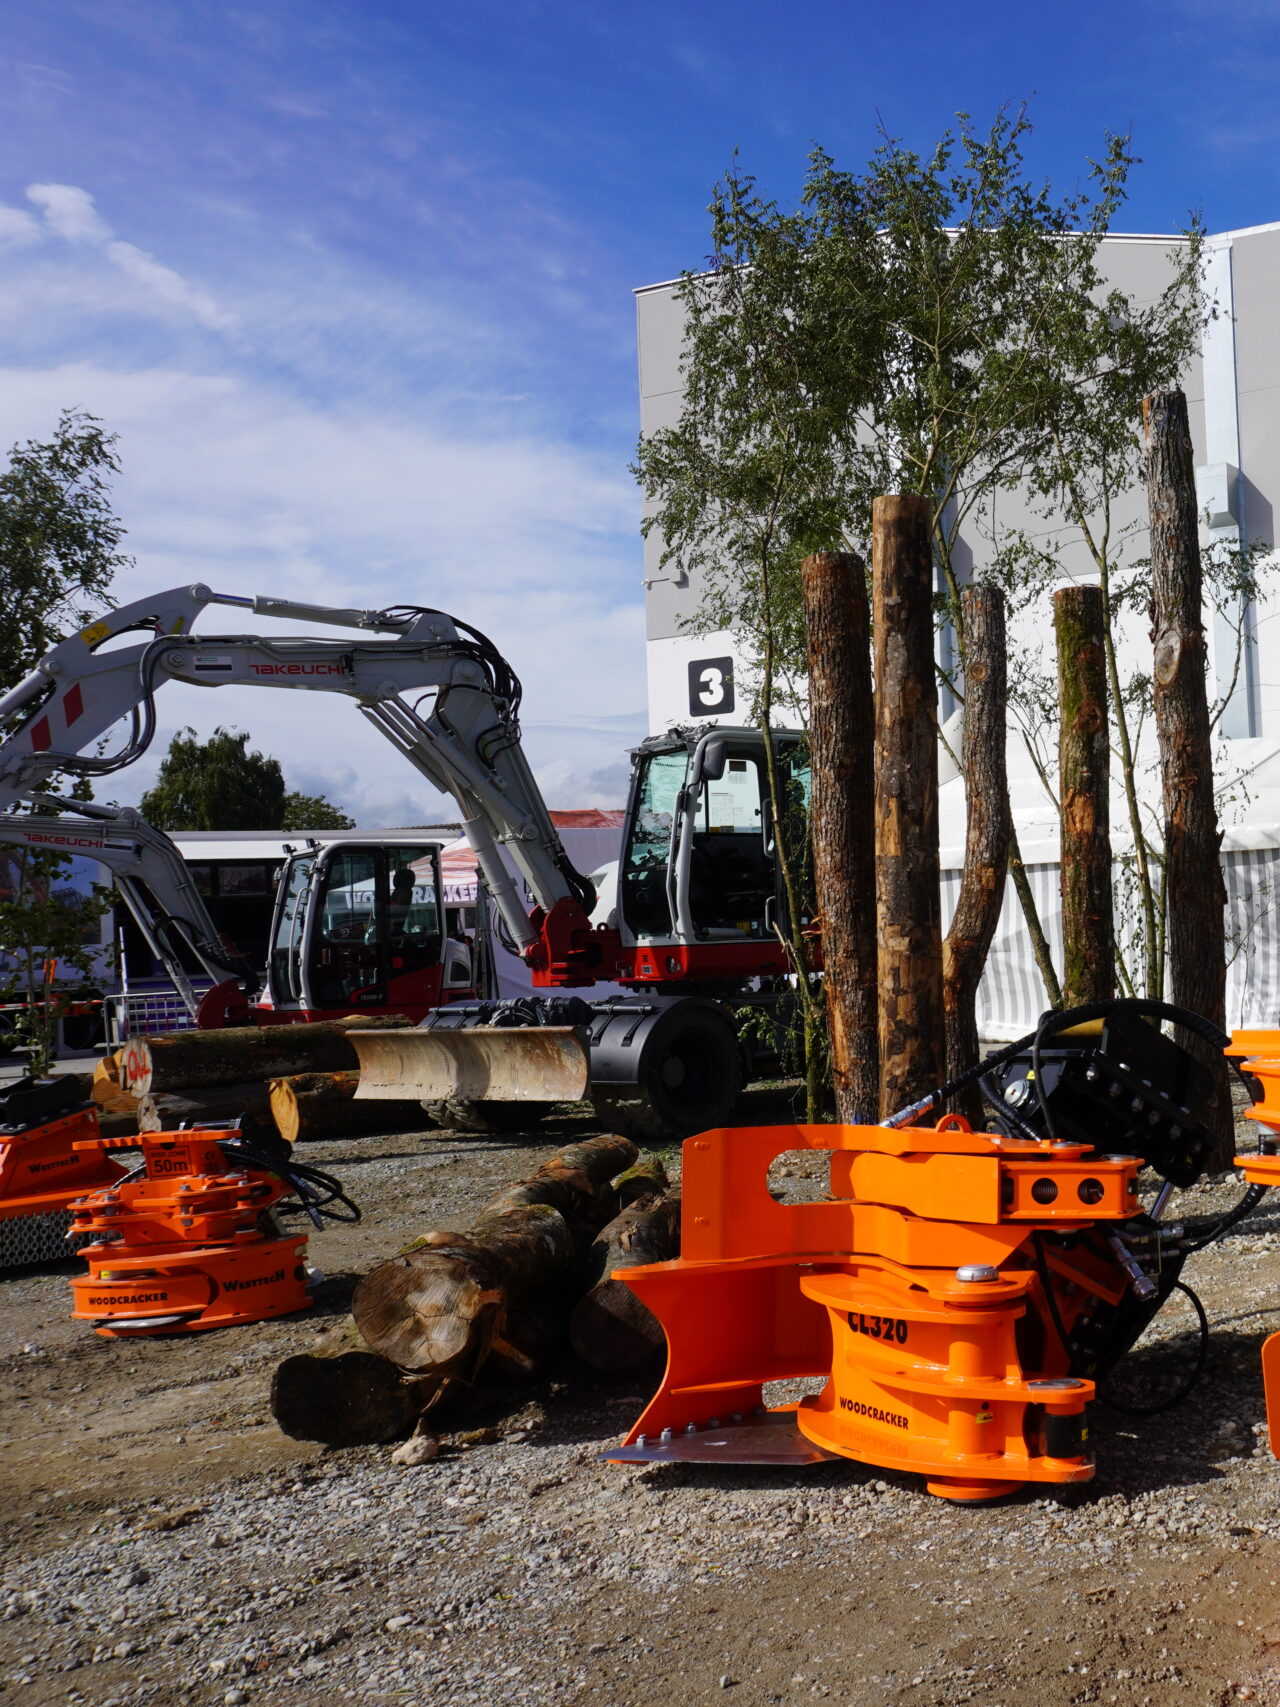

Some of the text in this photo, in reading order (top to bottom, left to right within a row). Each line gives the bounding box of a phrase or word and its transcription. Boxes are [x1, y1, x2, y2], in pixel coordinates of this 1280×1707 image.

[699, 667, 724, 706] 3
[23, 833, 105, 849] TAKEUCHI
[153, 1159, 188, 1173] 50m
[88, 1292, 168, 1305] WOODCRACKER
[847, 1312, 908, 1345] CL320
[839, 1396, 909, 1430] WOODCRACKER
